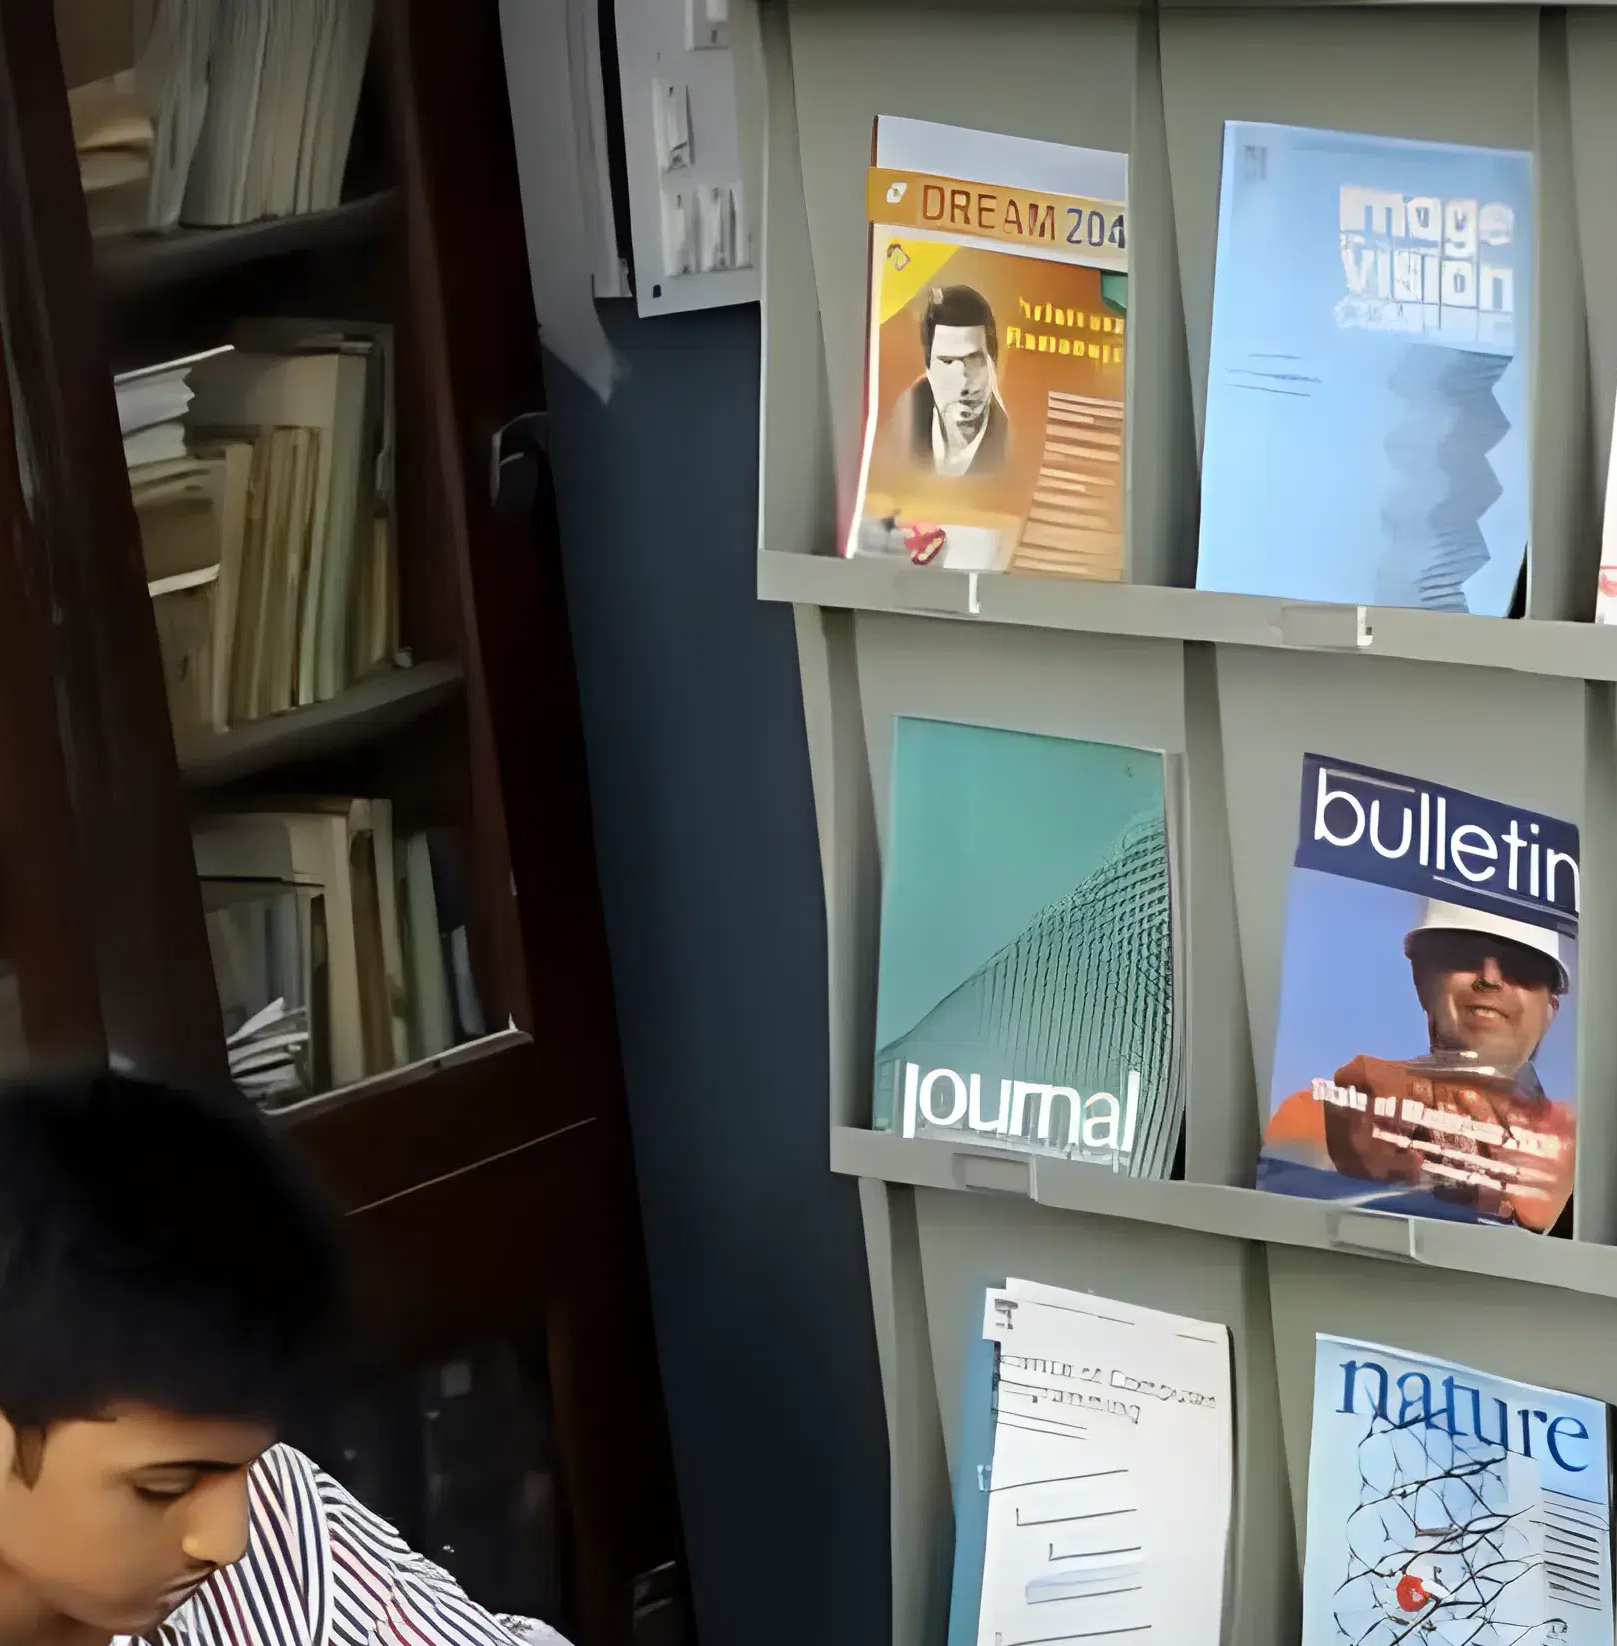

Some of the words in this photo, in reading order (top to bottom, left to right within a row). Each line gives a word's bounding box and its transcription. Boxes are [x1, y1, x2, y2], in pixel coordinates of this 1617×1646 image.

[922, 183, 1056, 241] DREAM
[1313, 766, 1581, 914] bulletin
[1334, 1357, 1591, 1474] nature
